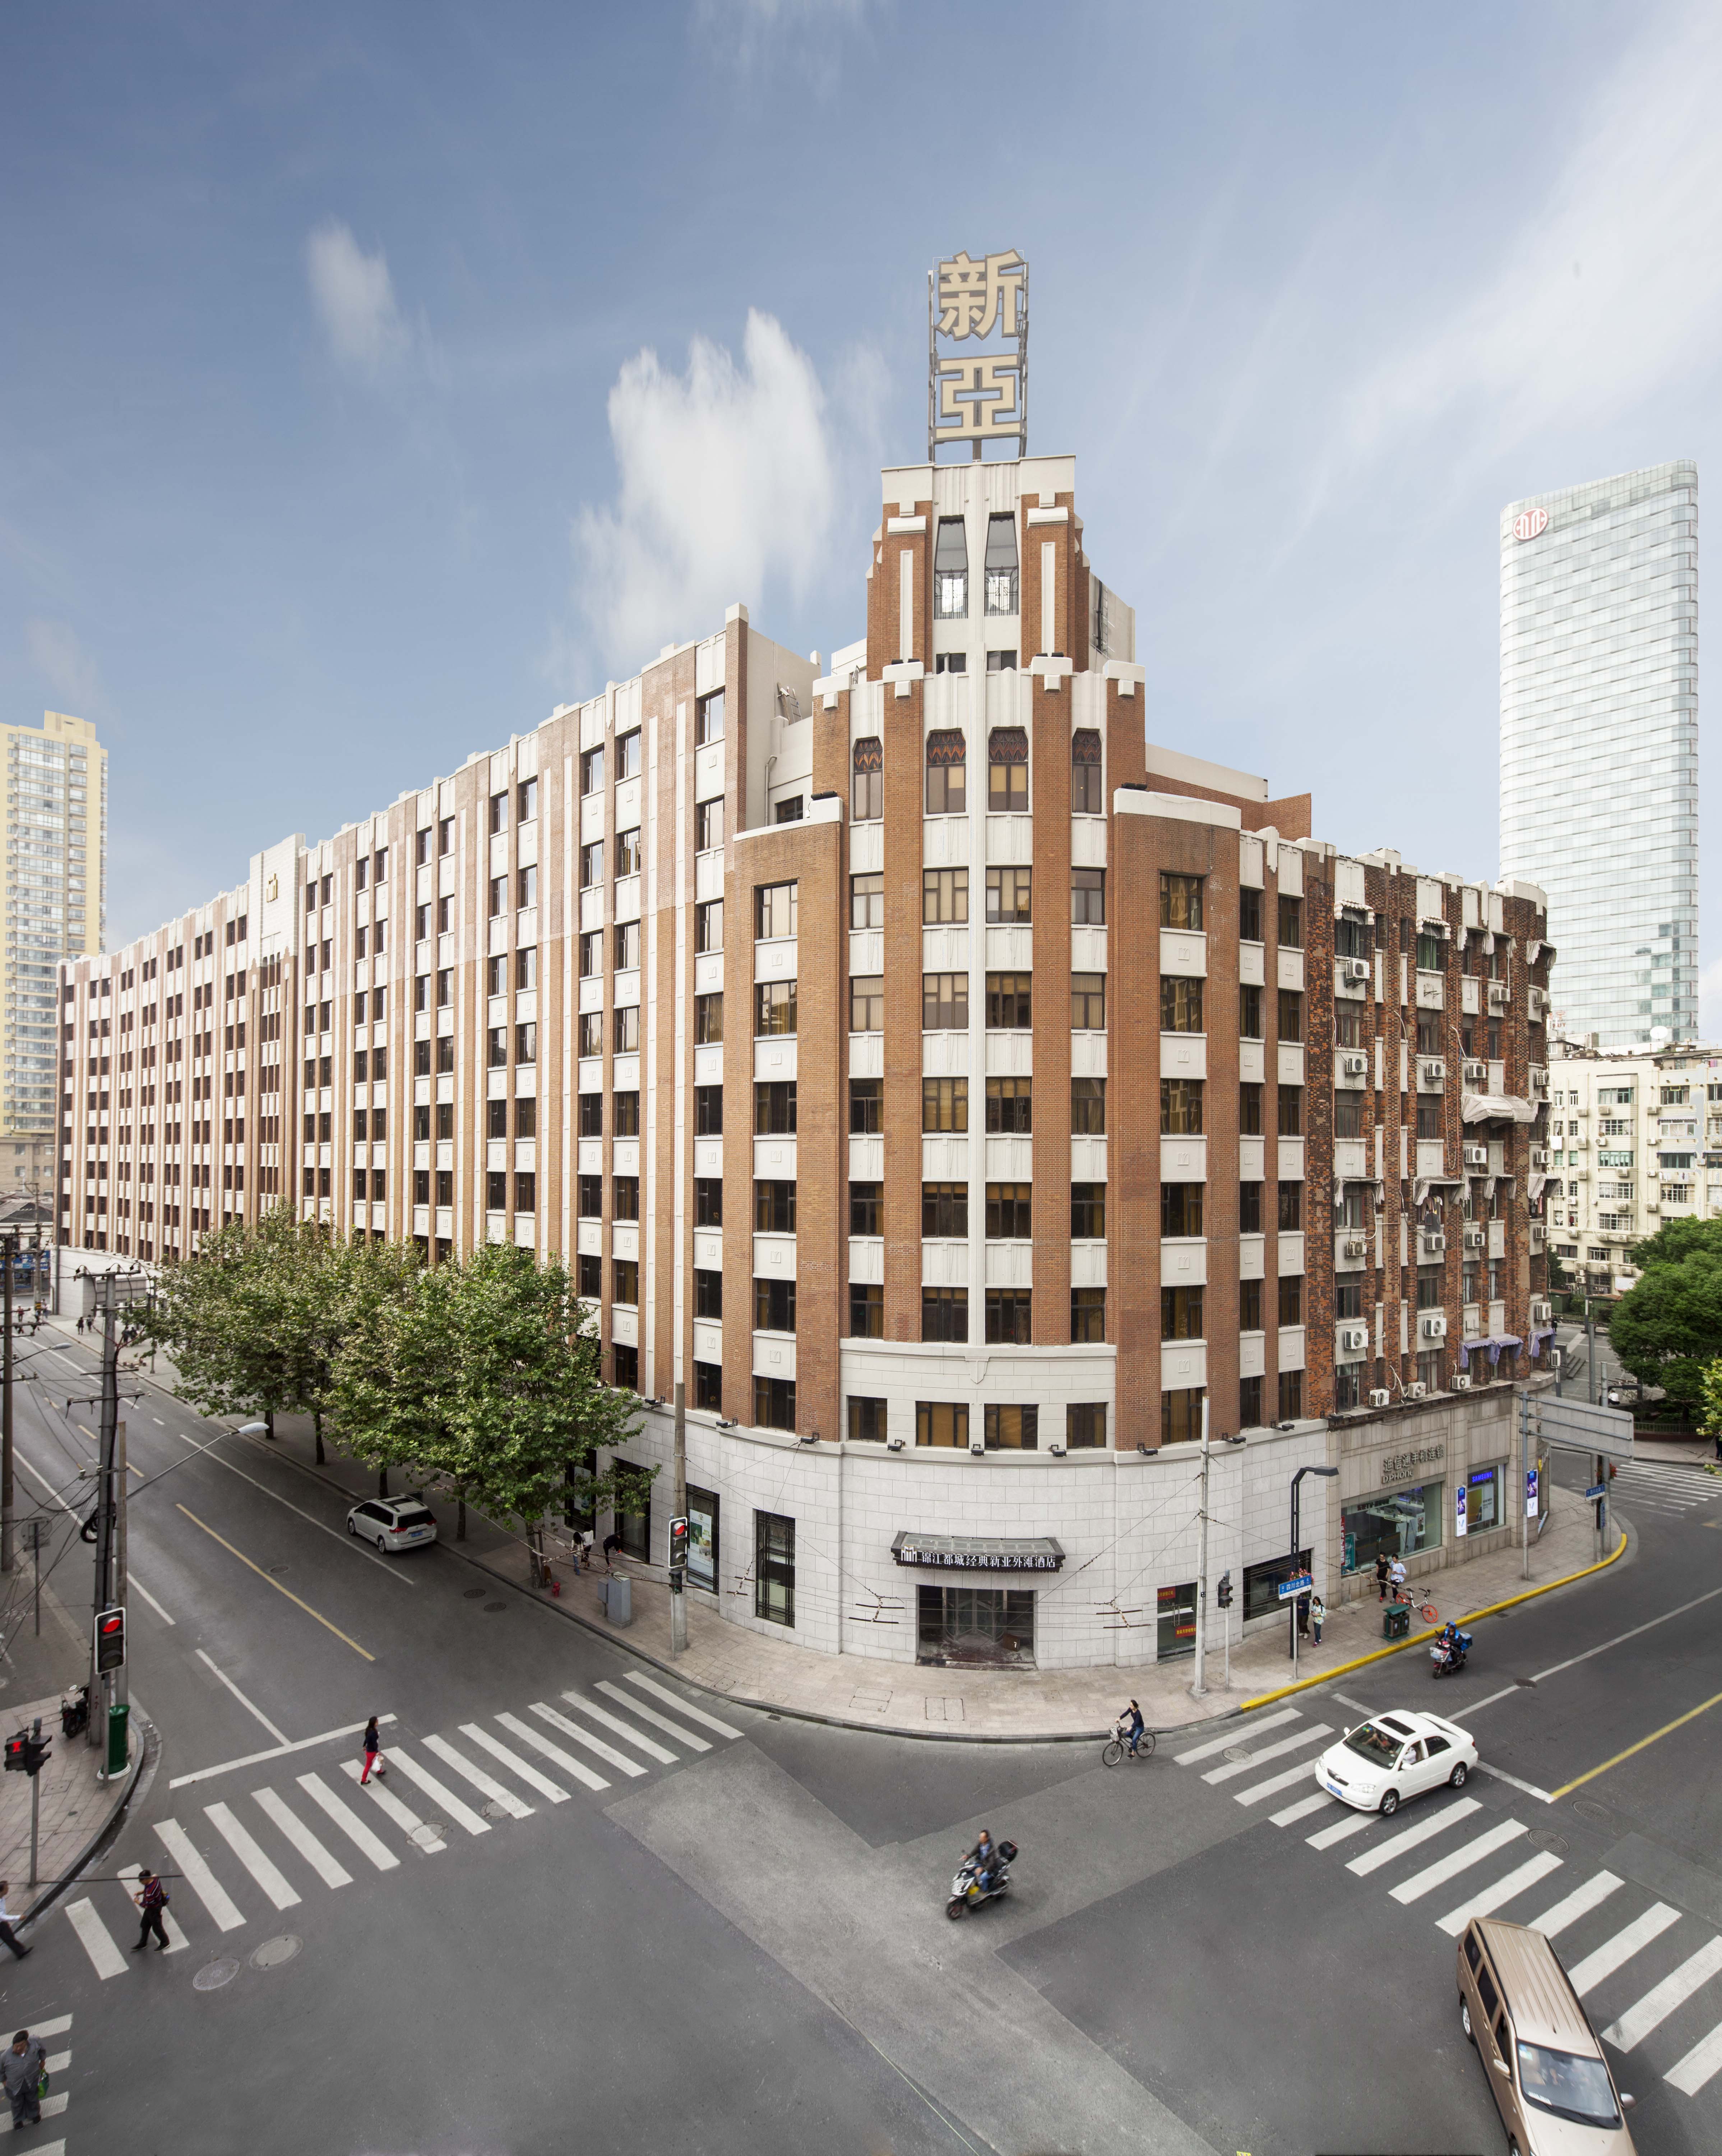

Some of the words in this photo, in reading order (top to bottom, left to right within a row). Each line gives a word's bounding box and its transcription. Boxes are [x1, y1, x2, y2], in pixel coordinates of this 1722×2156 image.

[935, 249, 1024, 439] 新亞
[1384, 1444, 1444, 1472] 迪信通手机连锁
[1472, 1472, 1492, 1483] SAMSUNG
[922, 1551, 1056, 1568] 锦江都城经典新亚外滩酒店
[1286, 1579, 1304, 1591] 四川北路
